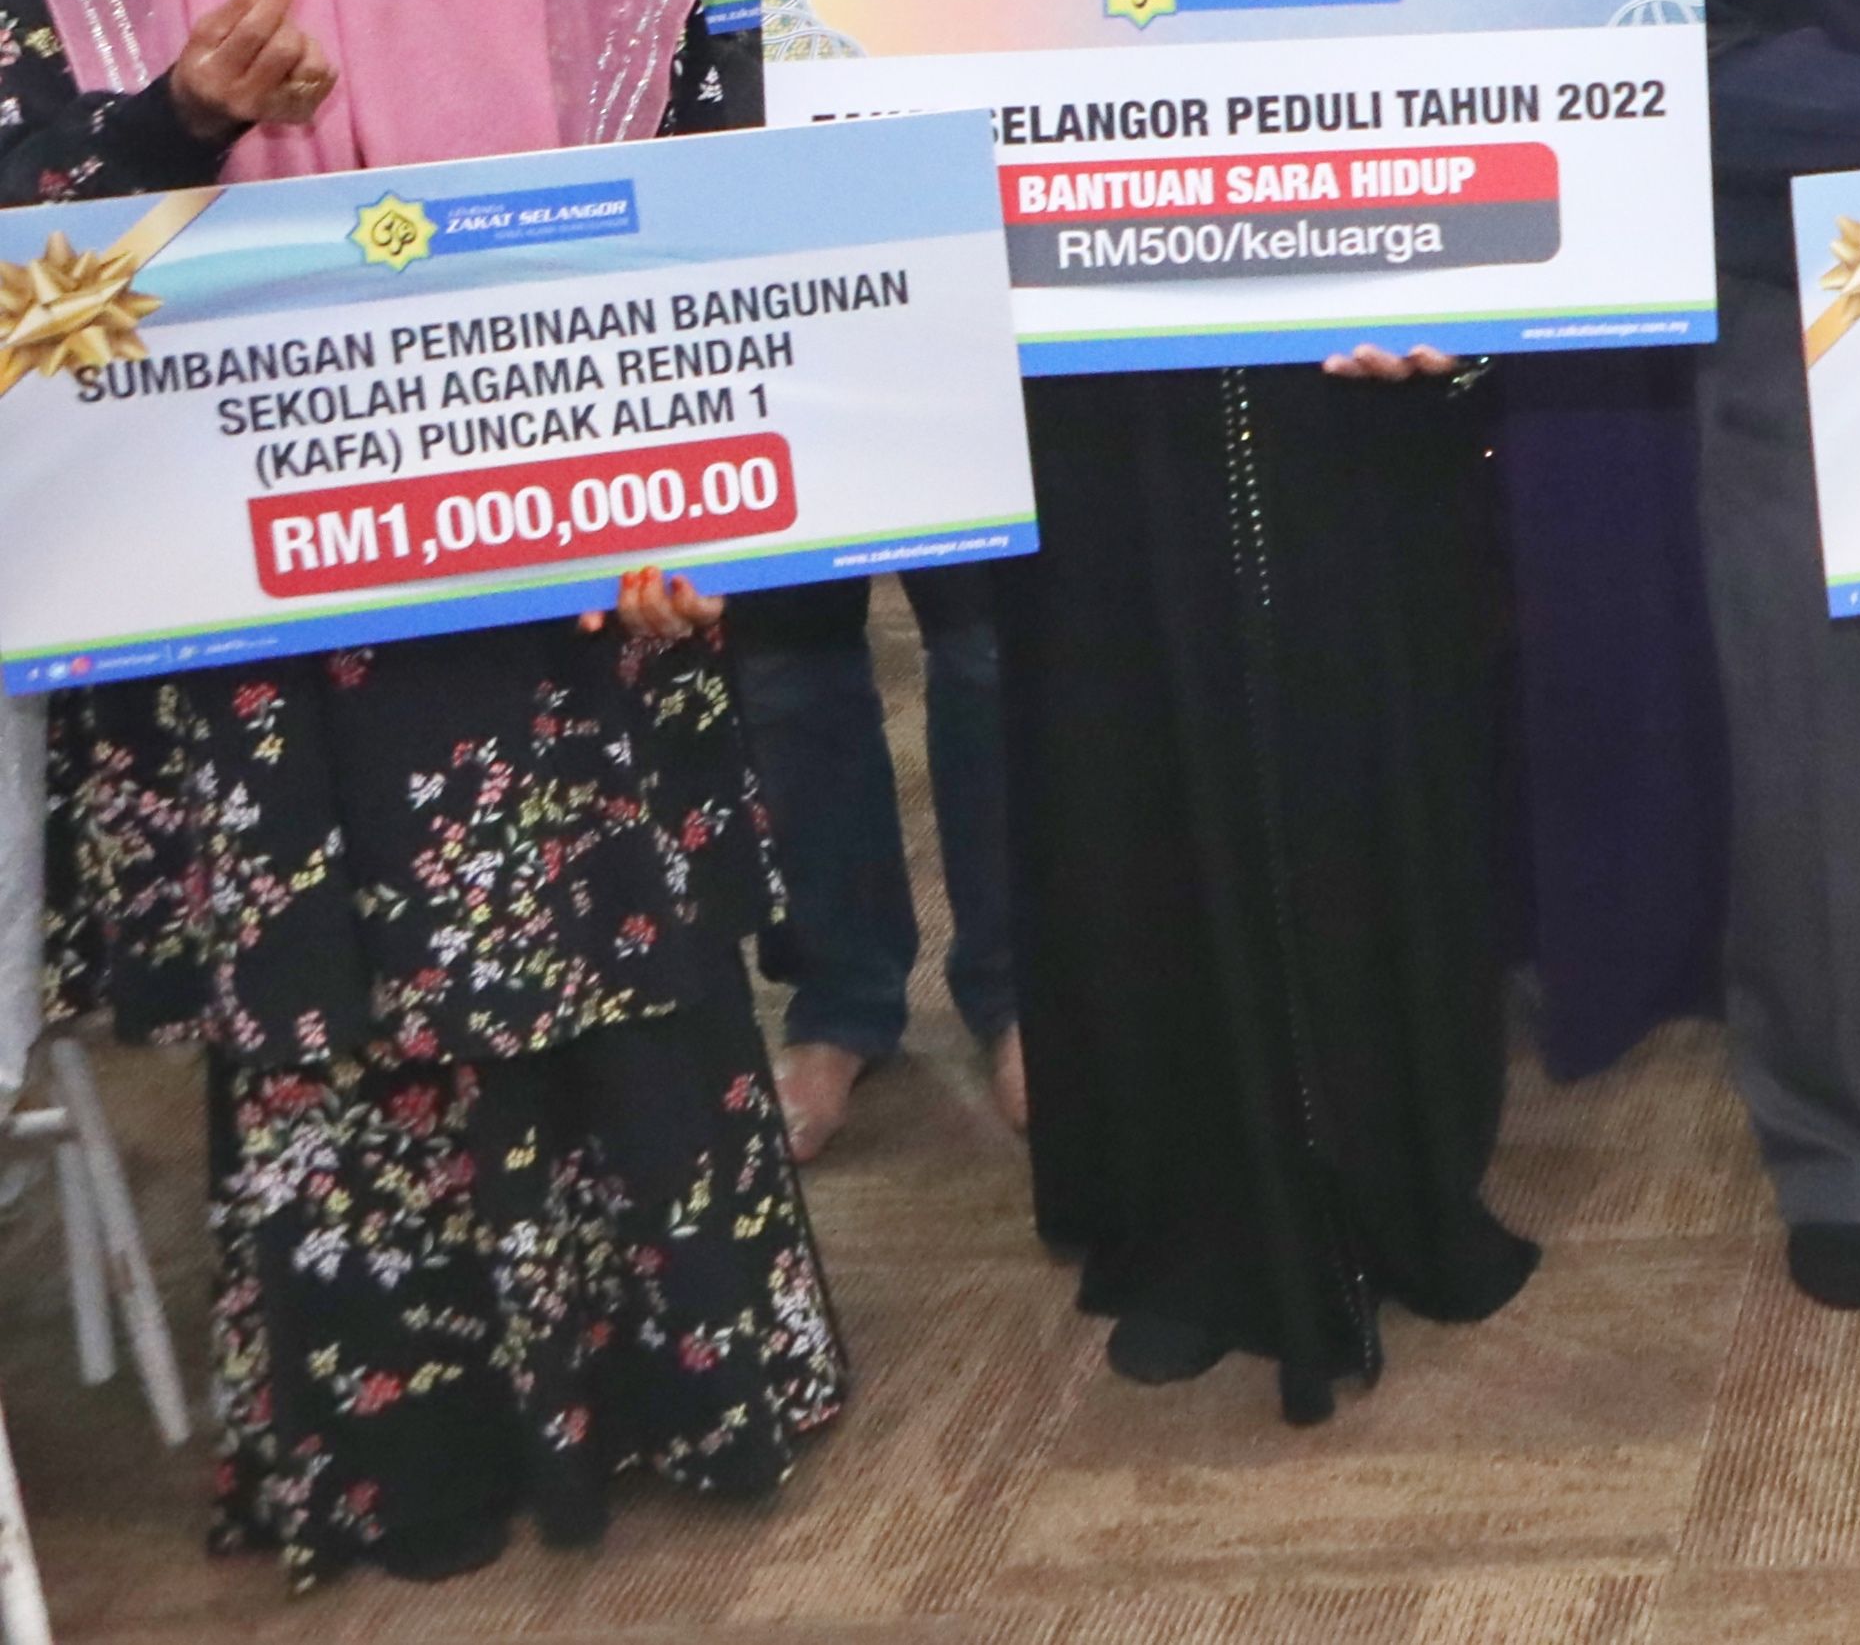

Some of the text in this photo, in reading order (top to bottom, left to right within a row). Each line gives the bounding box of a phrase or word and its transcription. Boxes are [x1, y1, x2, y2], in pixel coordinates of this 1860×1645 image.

[1228, 92, 1380, 134] PEDULI
[1397, 86, 1537, 126] TAHUN
[1559, 81, 1664, 119] 2022
[446, 212, 513, 234] ZAKAT
[518, 200, 627, 227] SELANGOR
[1019, 156, 1476, 213] BANTUAN SARA HIDUP
[1058, 219, 1444, 269] RM500/keluarga
[73, 271, 907, 402] SUMBANGAN PEMBINAAN BANGUNAN
[219, 332, 792, 435] SEKOLAH AGAMA RENDAH
[256, 385, 766, 487] (KAFA) PUNCAK ALAM 1
[272, 457, 778, 573] RM1,000,000.00
